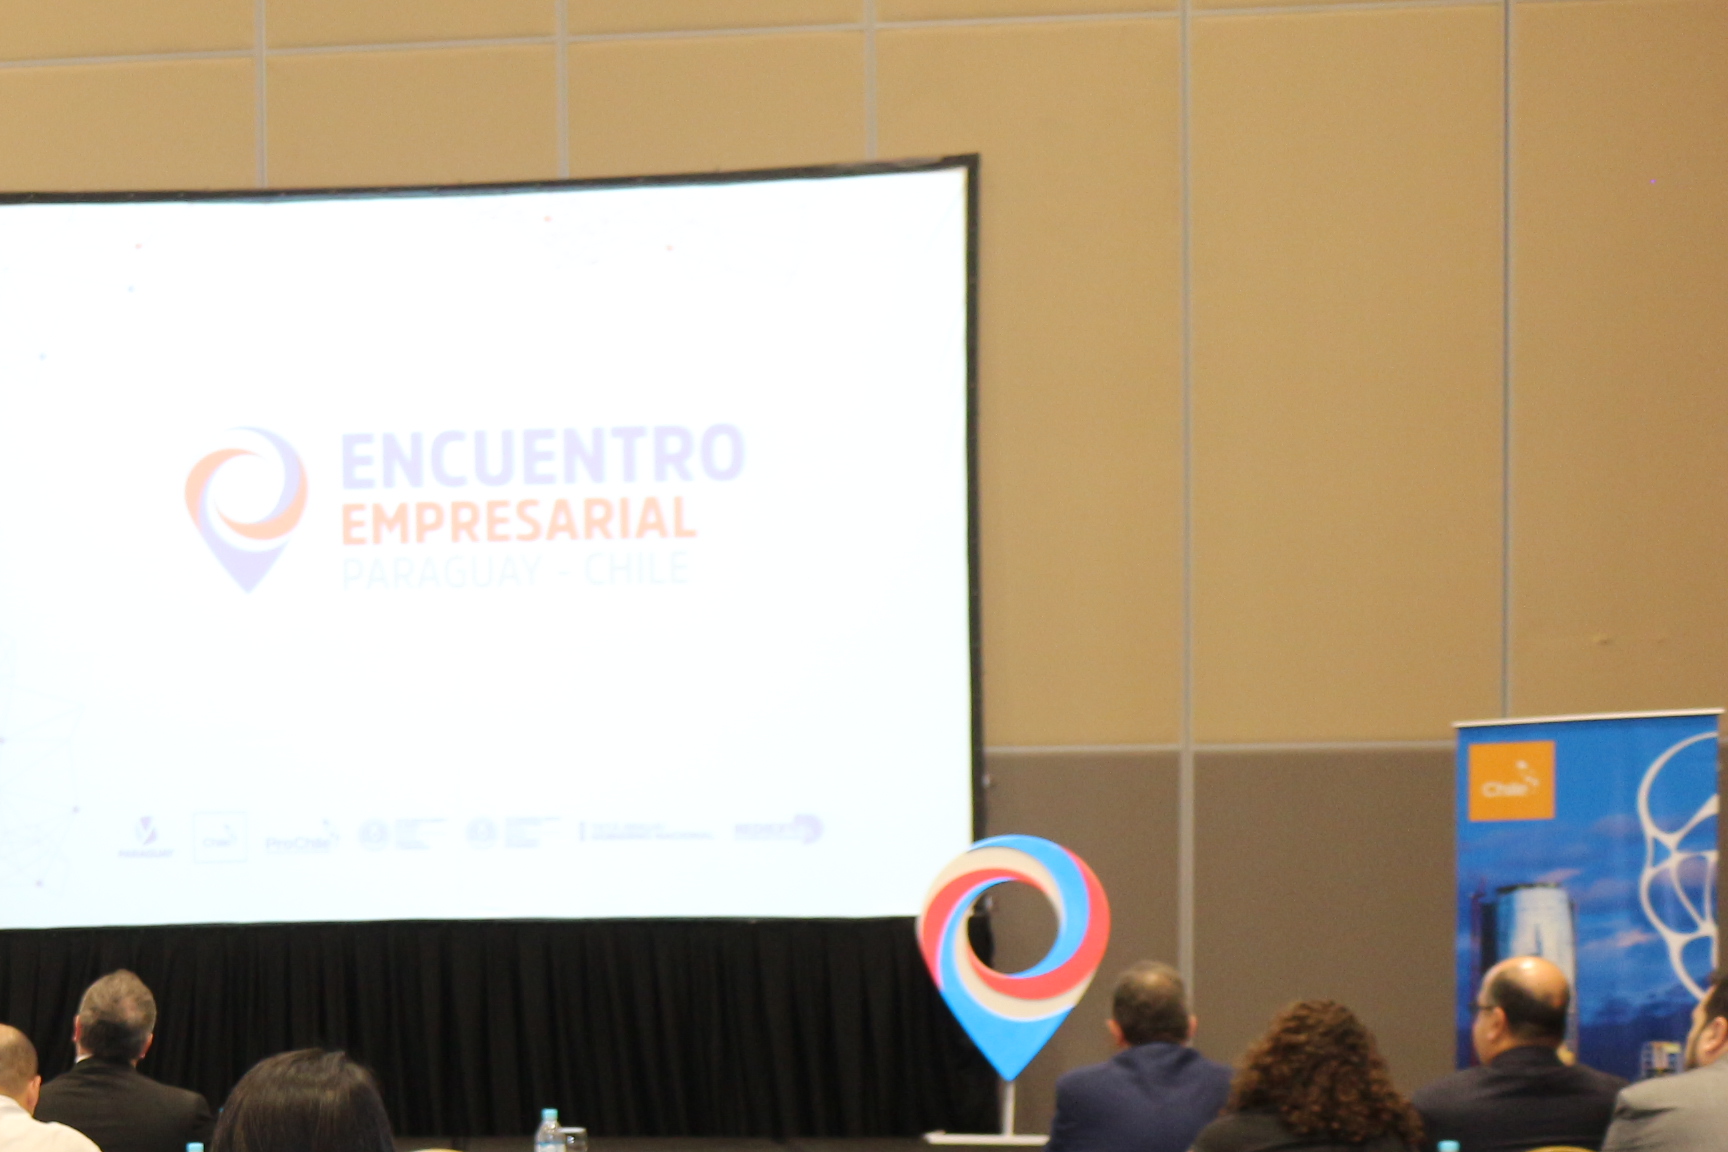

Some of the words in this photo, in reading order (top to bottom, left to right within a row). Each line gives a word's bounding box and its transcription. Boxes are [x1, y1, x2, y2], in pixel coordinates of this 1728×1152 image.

[341, 422, 746, 489] ENCUENTRO
[341, 496, 698, 546] EMPRESARIAL
[342, 553, 542, 591] PARAGUAY
[584, 550, 688, 585] CHILE
